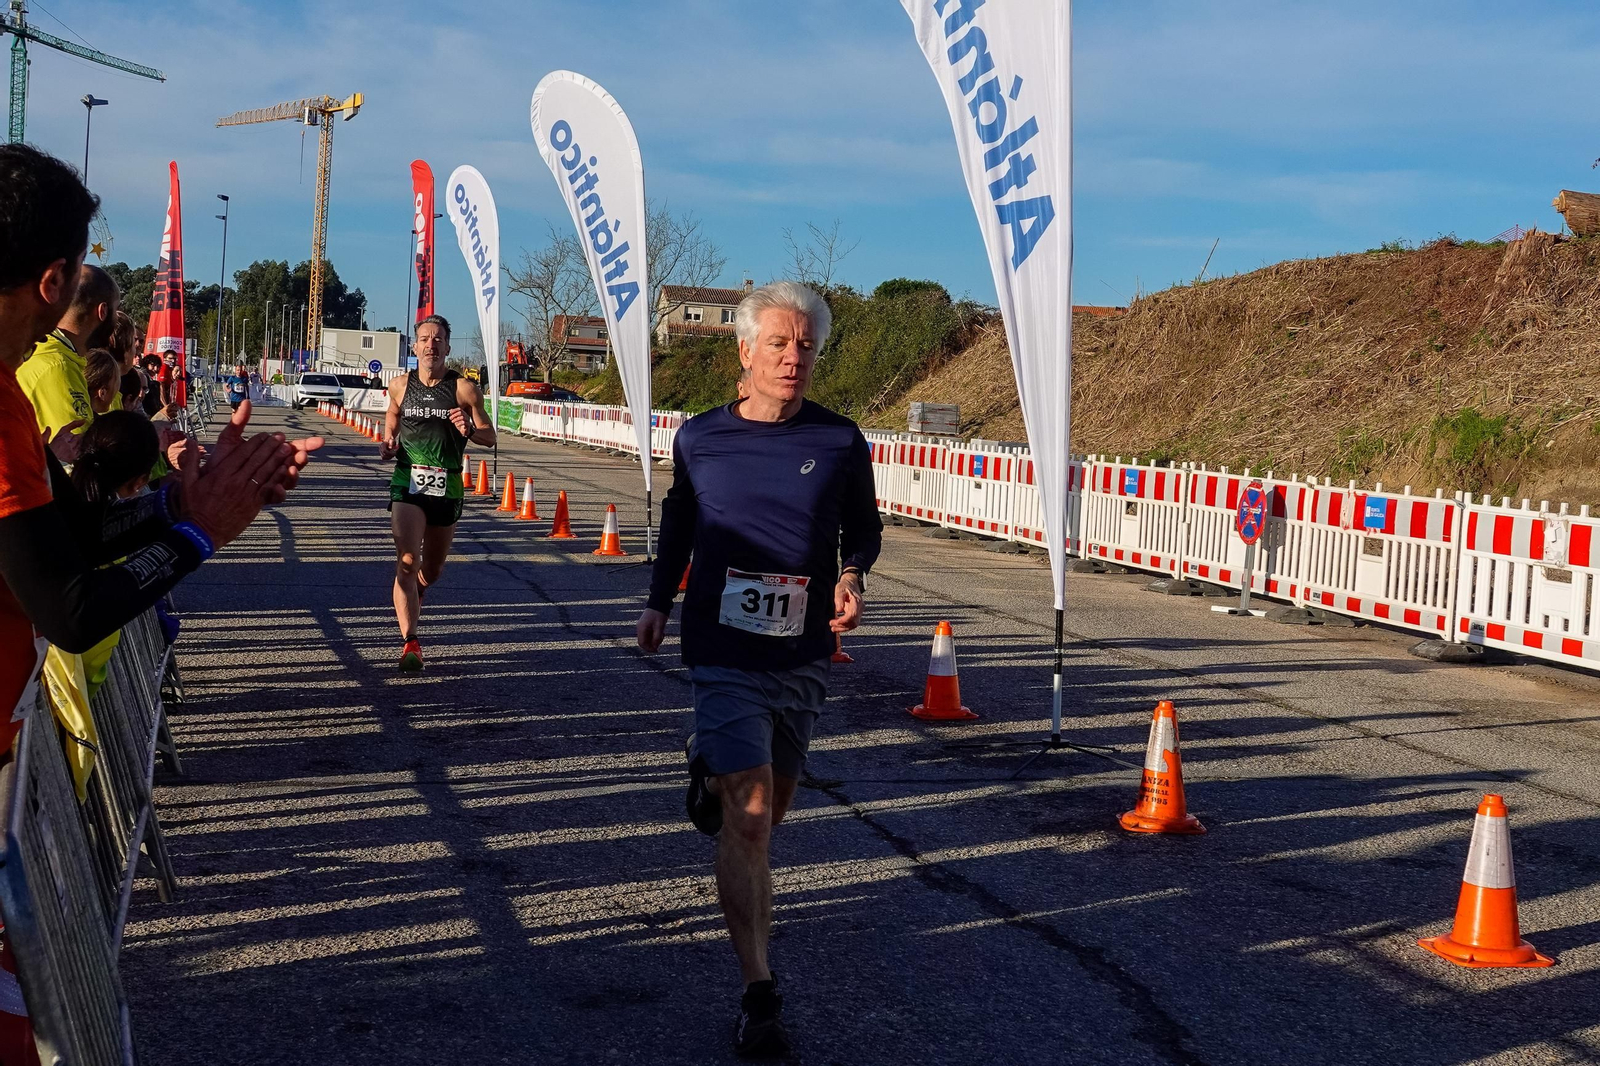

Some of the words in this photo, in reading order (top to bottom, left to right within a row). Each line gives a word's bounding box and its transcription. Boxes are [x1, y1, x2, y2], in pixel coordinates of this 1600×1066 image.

[404, 406, 424, 417] máis
[416, 473, 446, 489] 323
[761, 575, 781, 584] VIGO
[741, 588, 790, 618] 311
